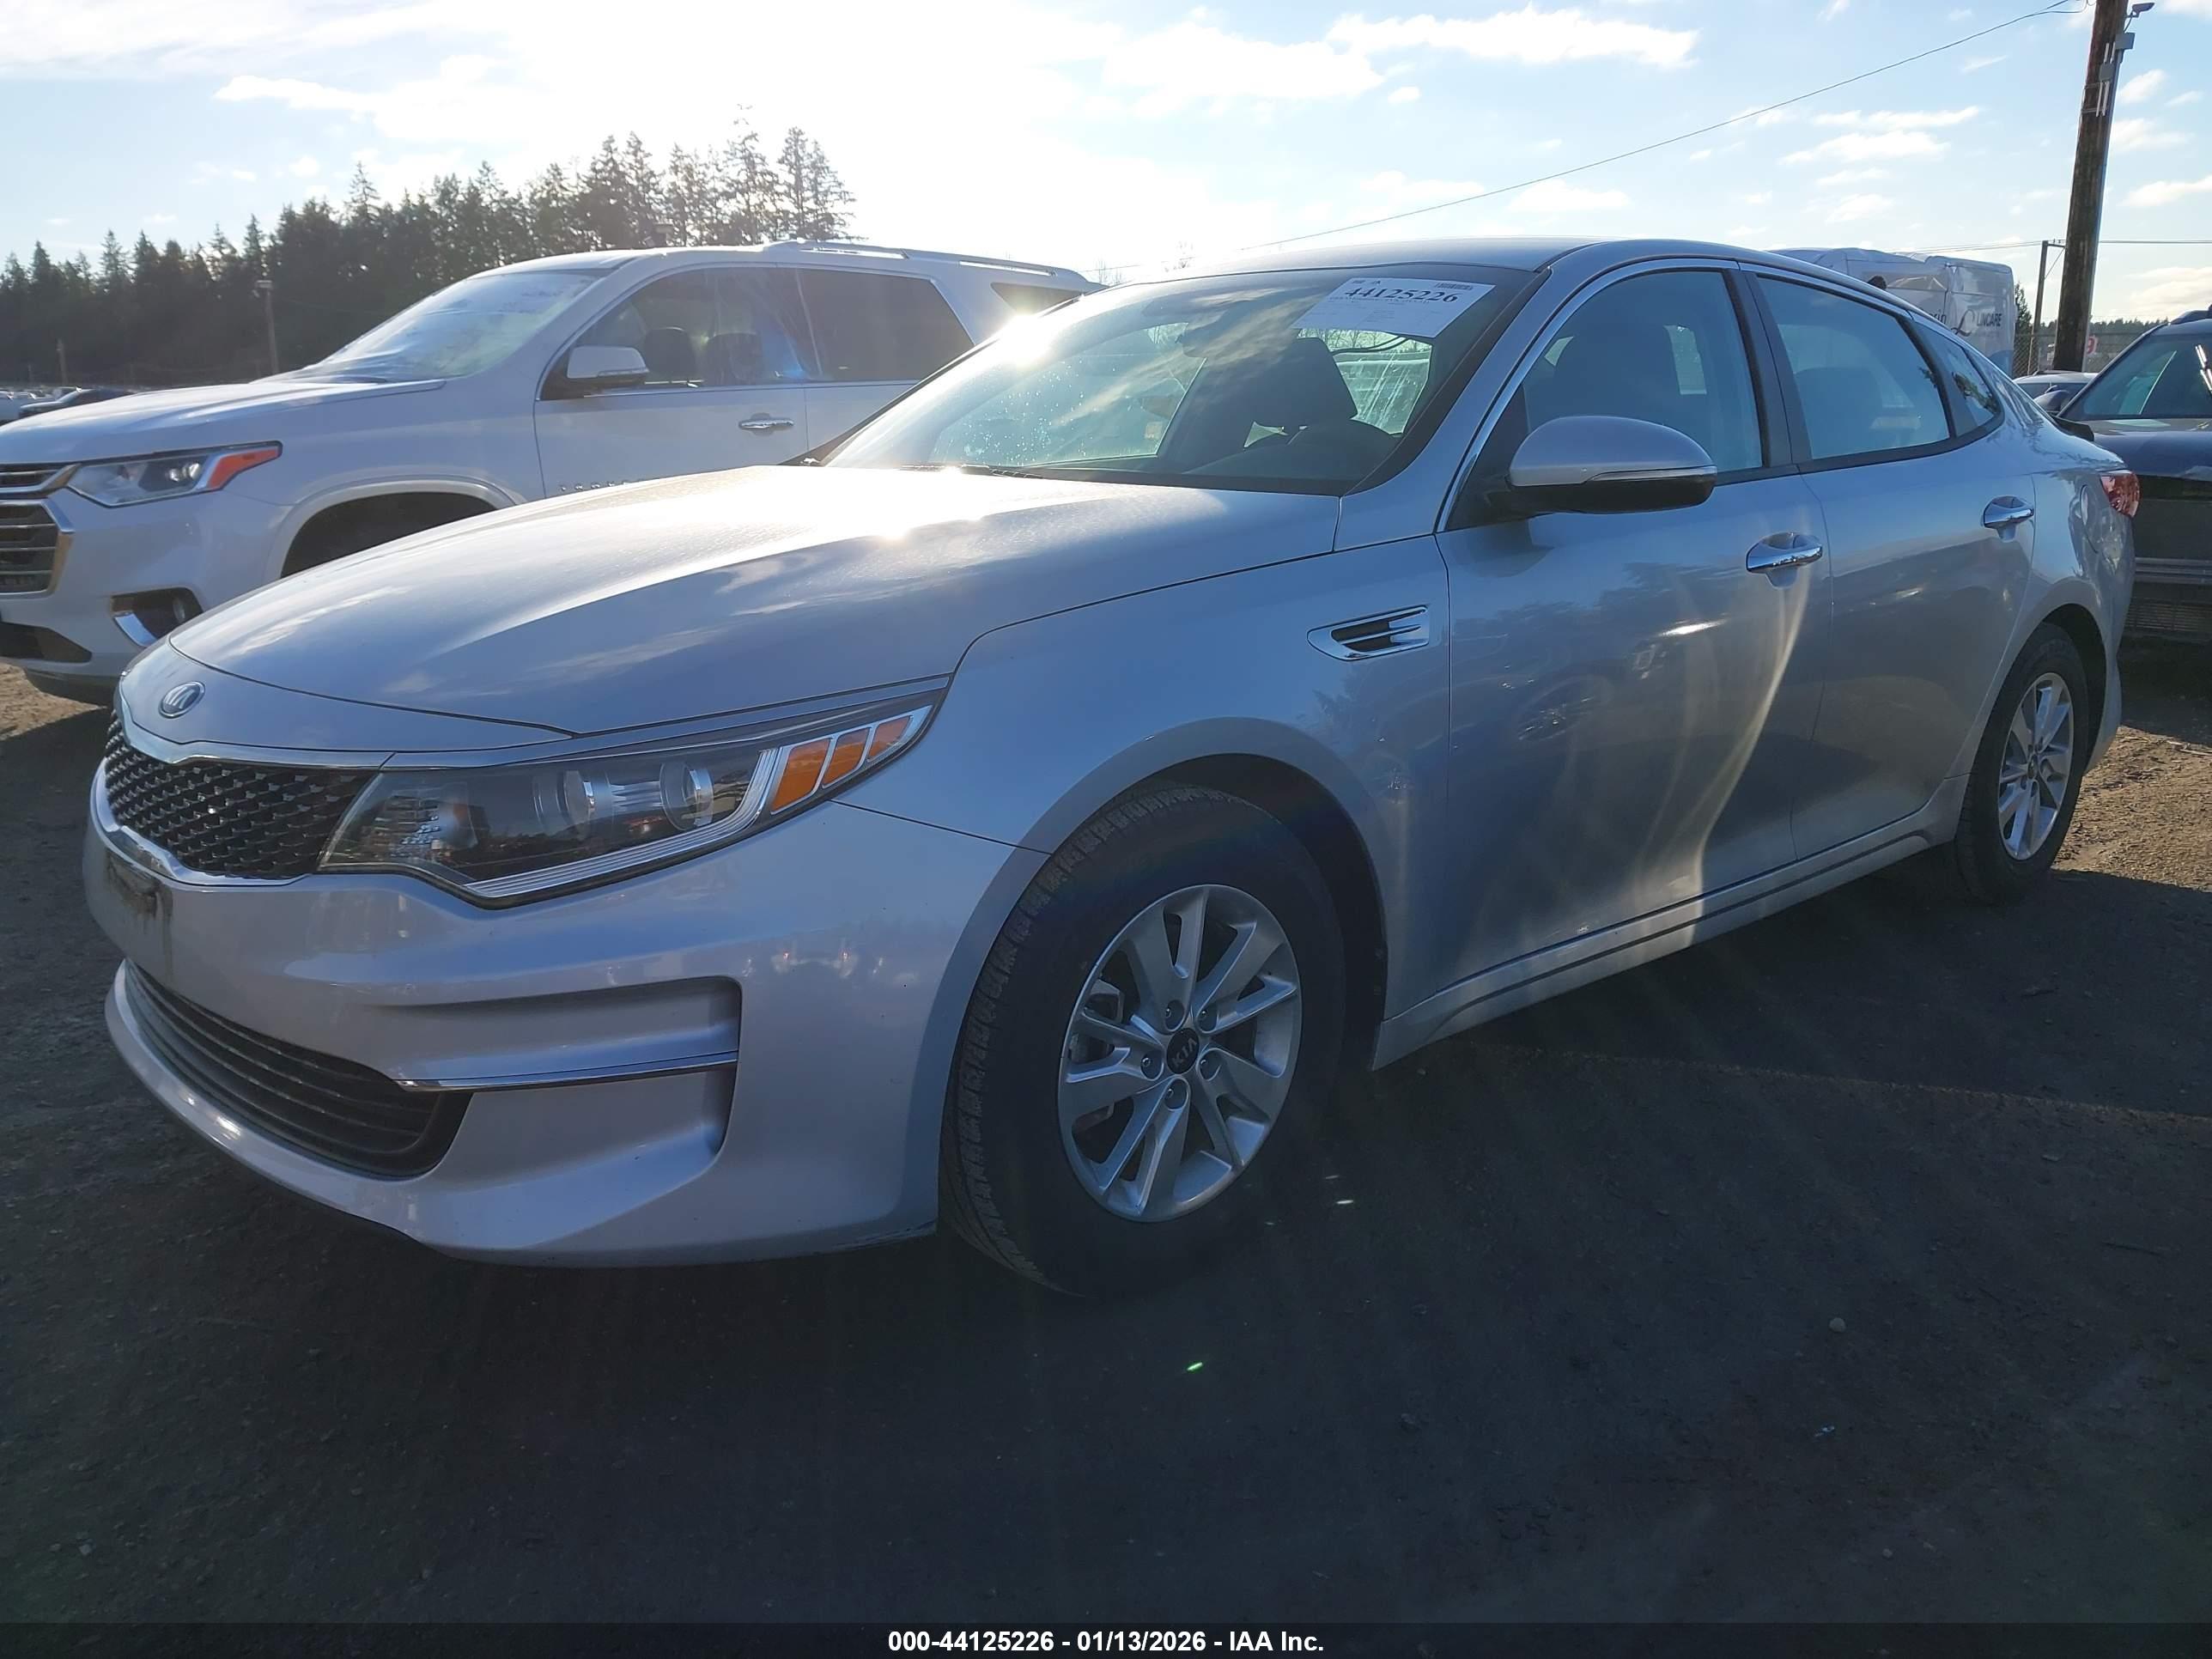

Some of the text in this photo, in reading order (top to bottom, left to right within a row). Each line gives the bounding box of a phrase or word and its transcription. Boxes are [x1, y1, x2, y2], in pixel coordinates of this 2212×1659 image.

[1345, 287, 1462, 302] 44125226
[1977, 313, 2002, 326] LINCARE
[1170, 1036, 1198, 1069] KIA
